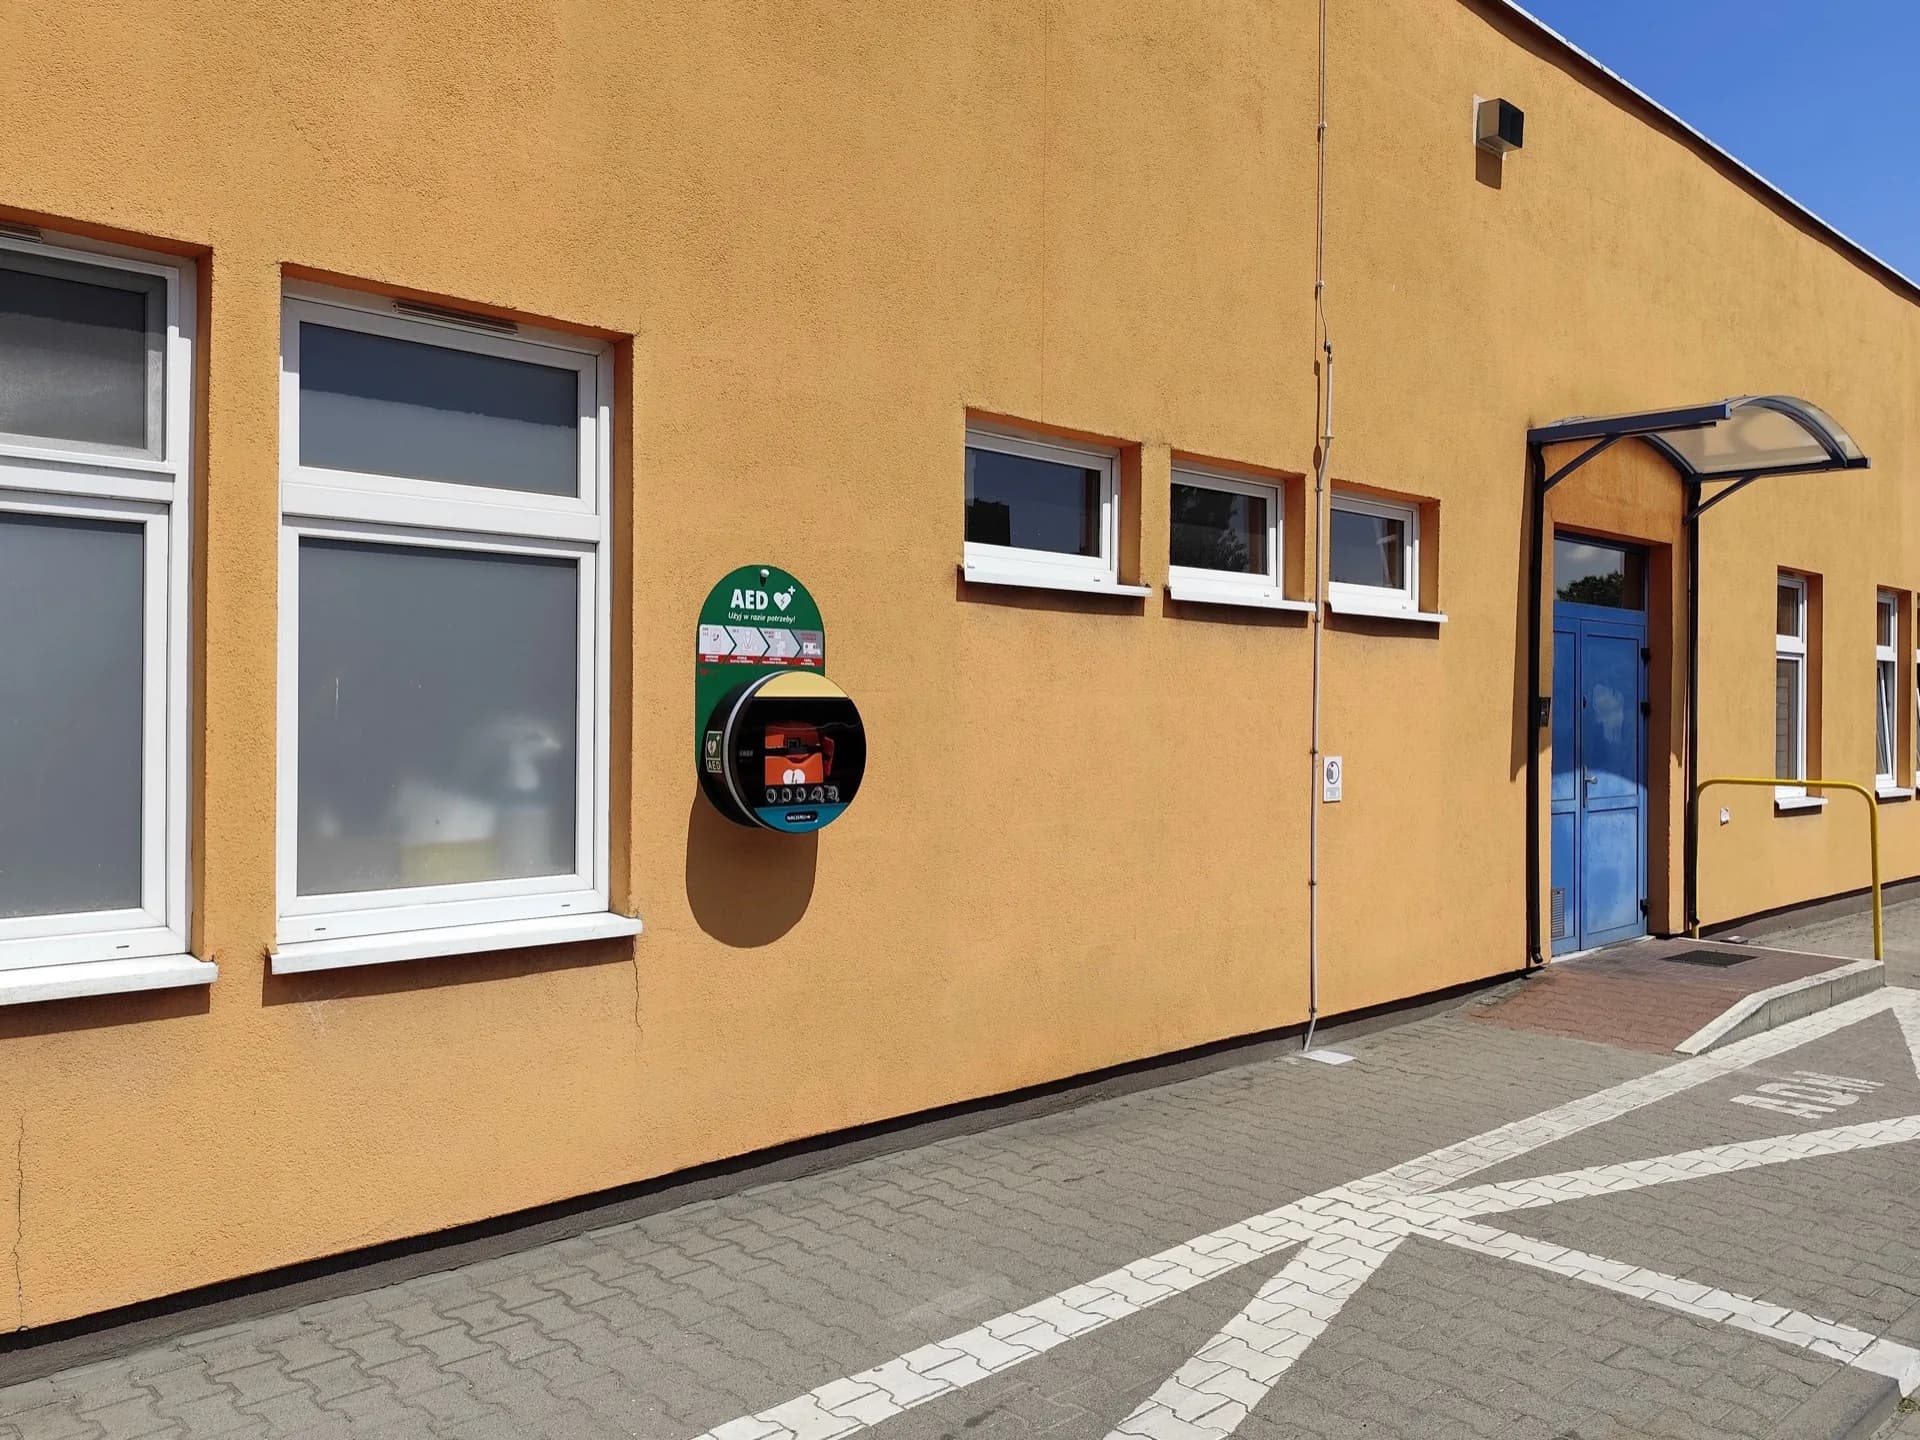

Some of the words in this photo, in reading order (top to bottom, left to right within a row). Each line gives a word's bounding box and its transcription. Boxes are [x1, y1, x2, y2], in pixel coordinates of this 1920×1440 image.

[730, 588, 769, 611] AED
[750, 613, 766, 621] razie
[766, 615, 796, 624] potrzeby!
[708, 760, 721, 770] AED
